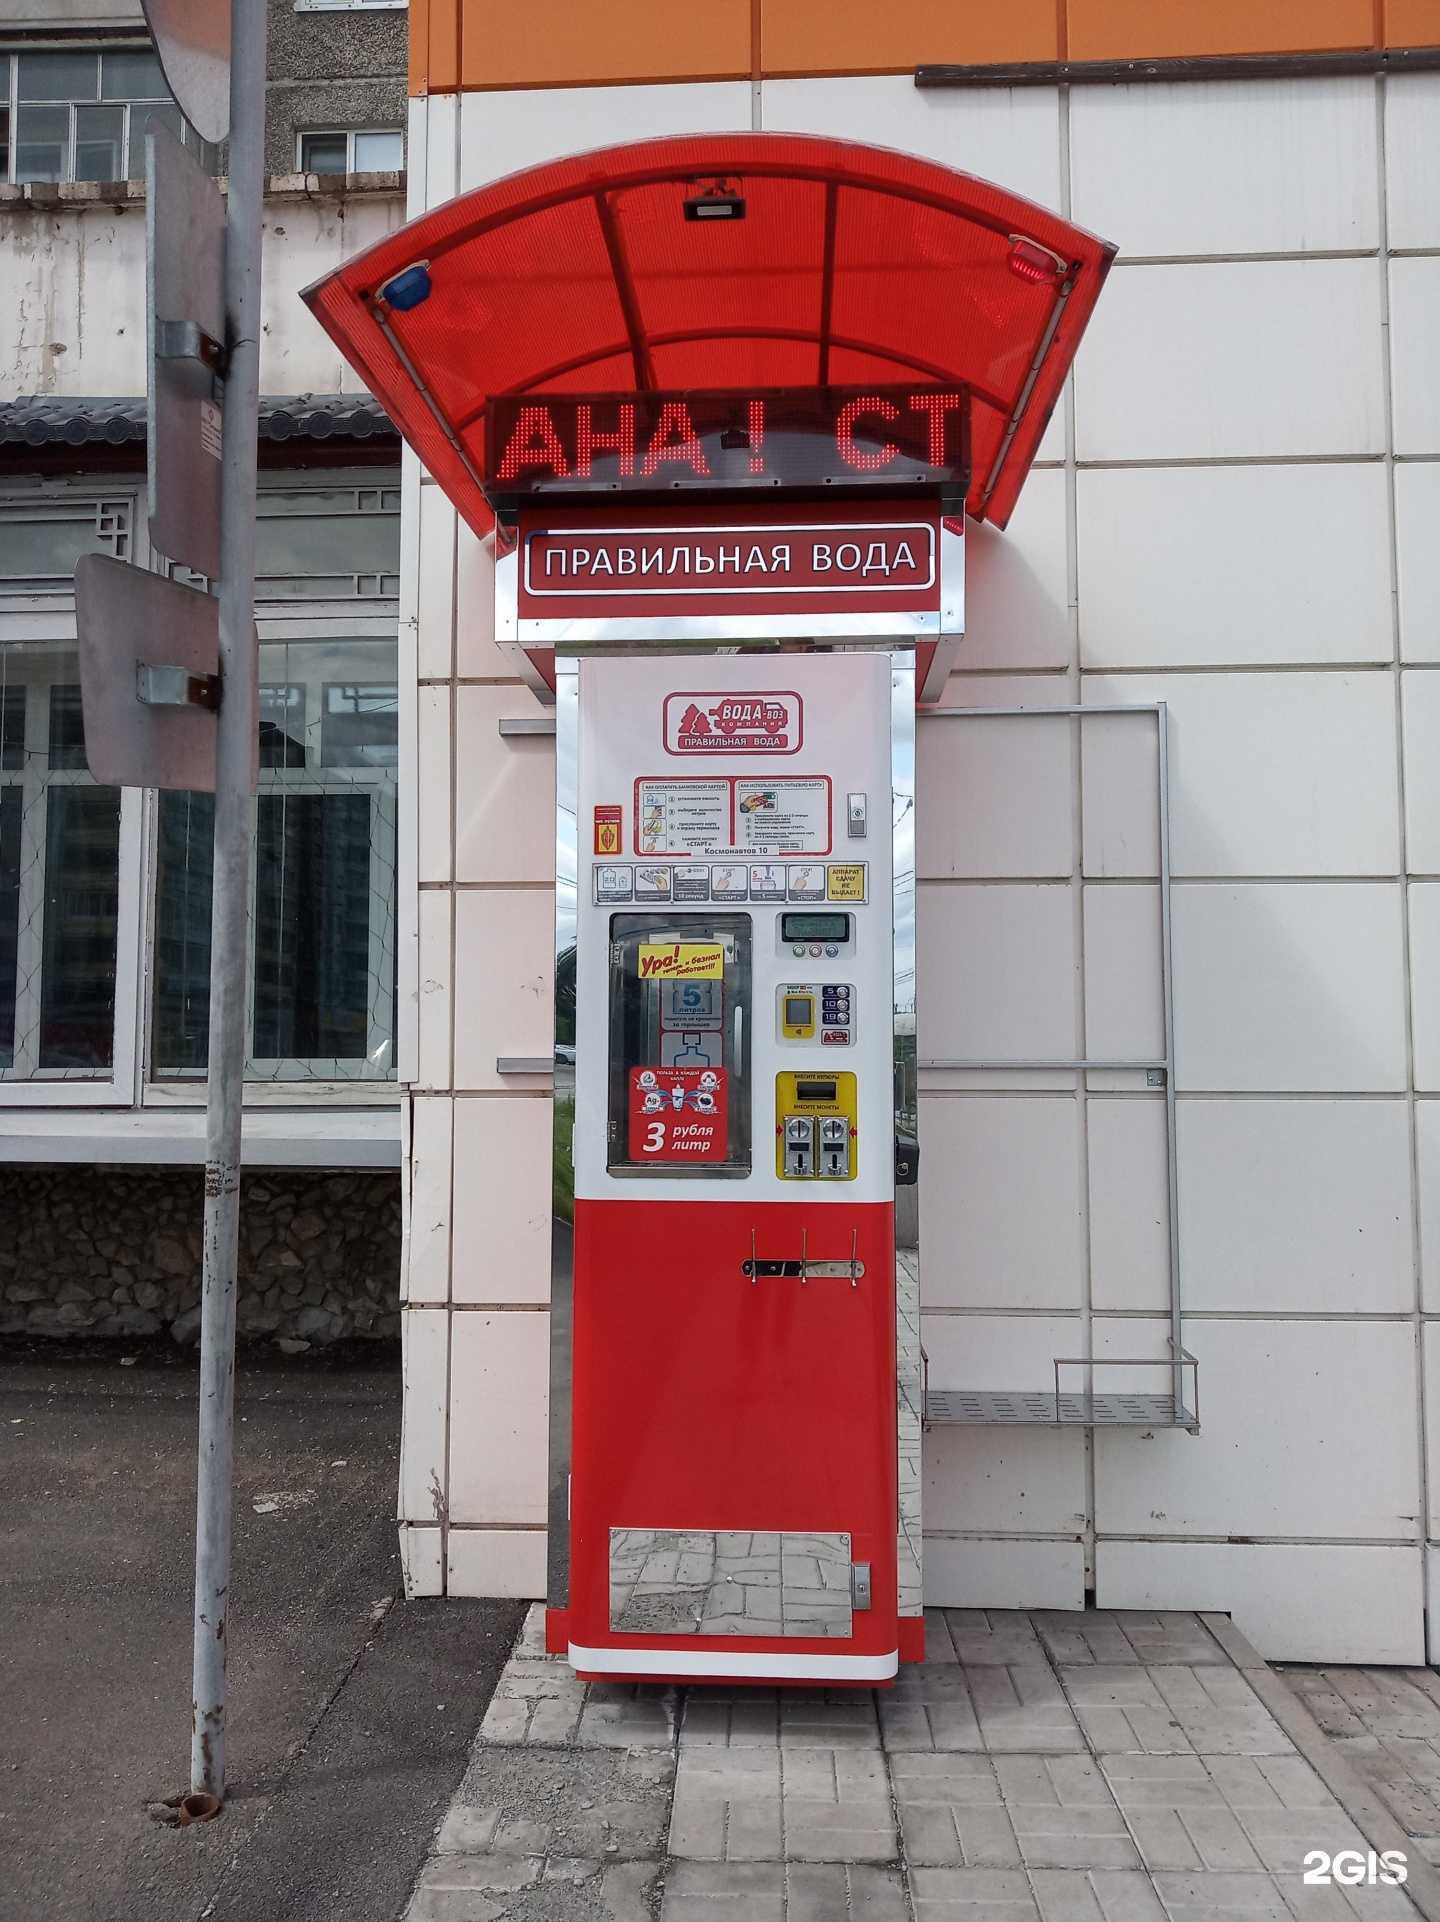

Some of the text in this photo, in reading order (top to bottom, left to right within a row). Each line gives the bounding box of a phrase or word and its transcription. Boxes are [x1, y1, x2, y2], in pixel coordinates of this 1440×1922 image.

[835, 393, 960, 471] СТ
[544, 541, 917, 577] ПРАВИЛЬНАЯ ВОДА
[722, 704, 784, 720] ВОДА-ВОЗ
[684, 736, 781, 747] ПРАВИЛЬНАЯ ВОДА
[704, 847, 757, 855] Космонавтов
[641, 945, 680, 977] Ура!
[691, 953, 721, 964] безнал
[682, 983, 701, 1007] 5
[642, 1122, 666, 1152] 3
[672, 1124, 714, 1138] рубля
[671, 1141, 711, 1152] литр
